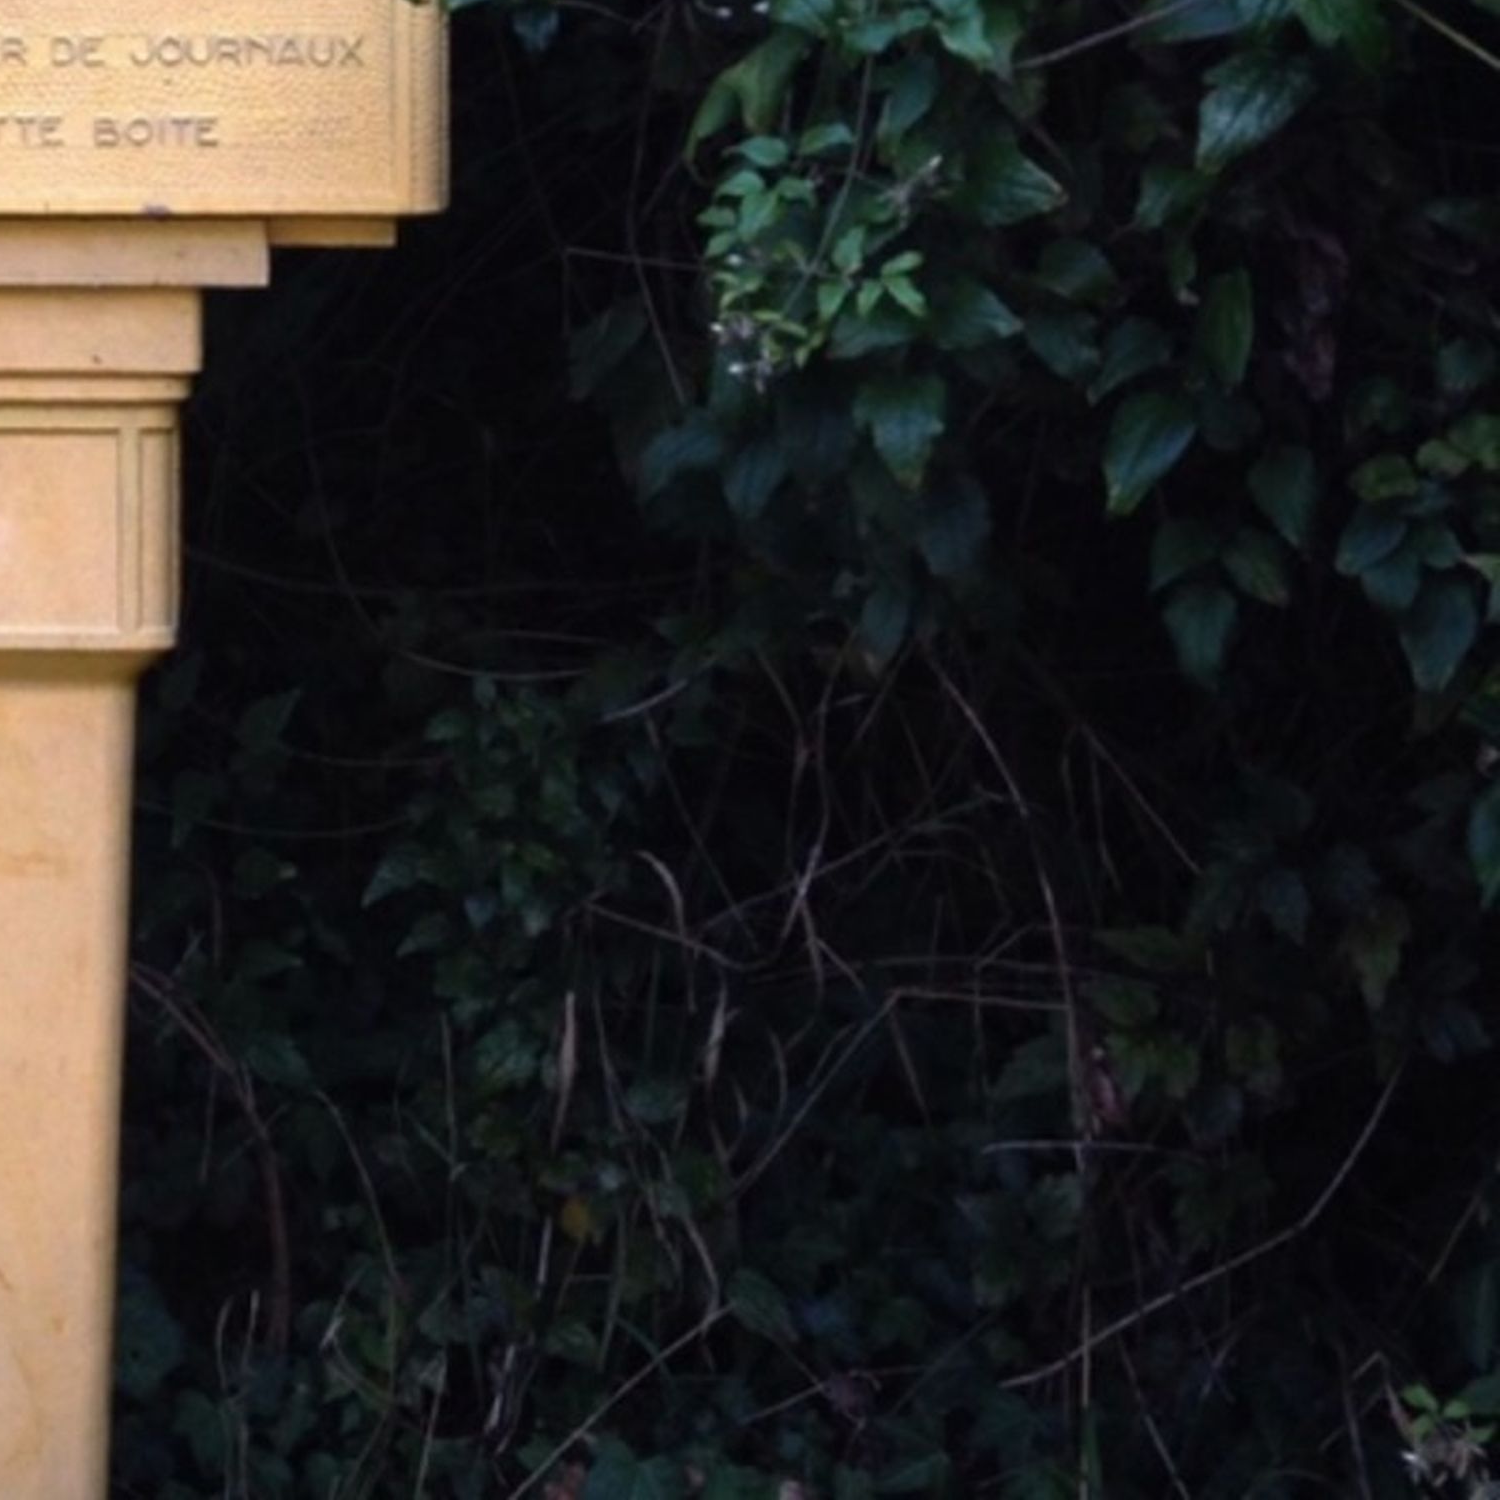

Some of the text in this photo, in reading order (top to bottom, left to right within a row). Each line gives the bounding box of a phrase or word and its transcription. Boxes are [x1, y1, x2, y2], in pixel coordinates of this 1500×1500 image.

[50, 36, 106, 68] DE
[129, 36, 365, 68] JOURNAUX
[93, 116, 221, 148] BOITE
